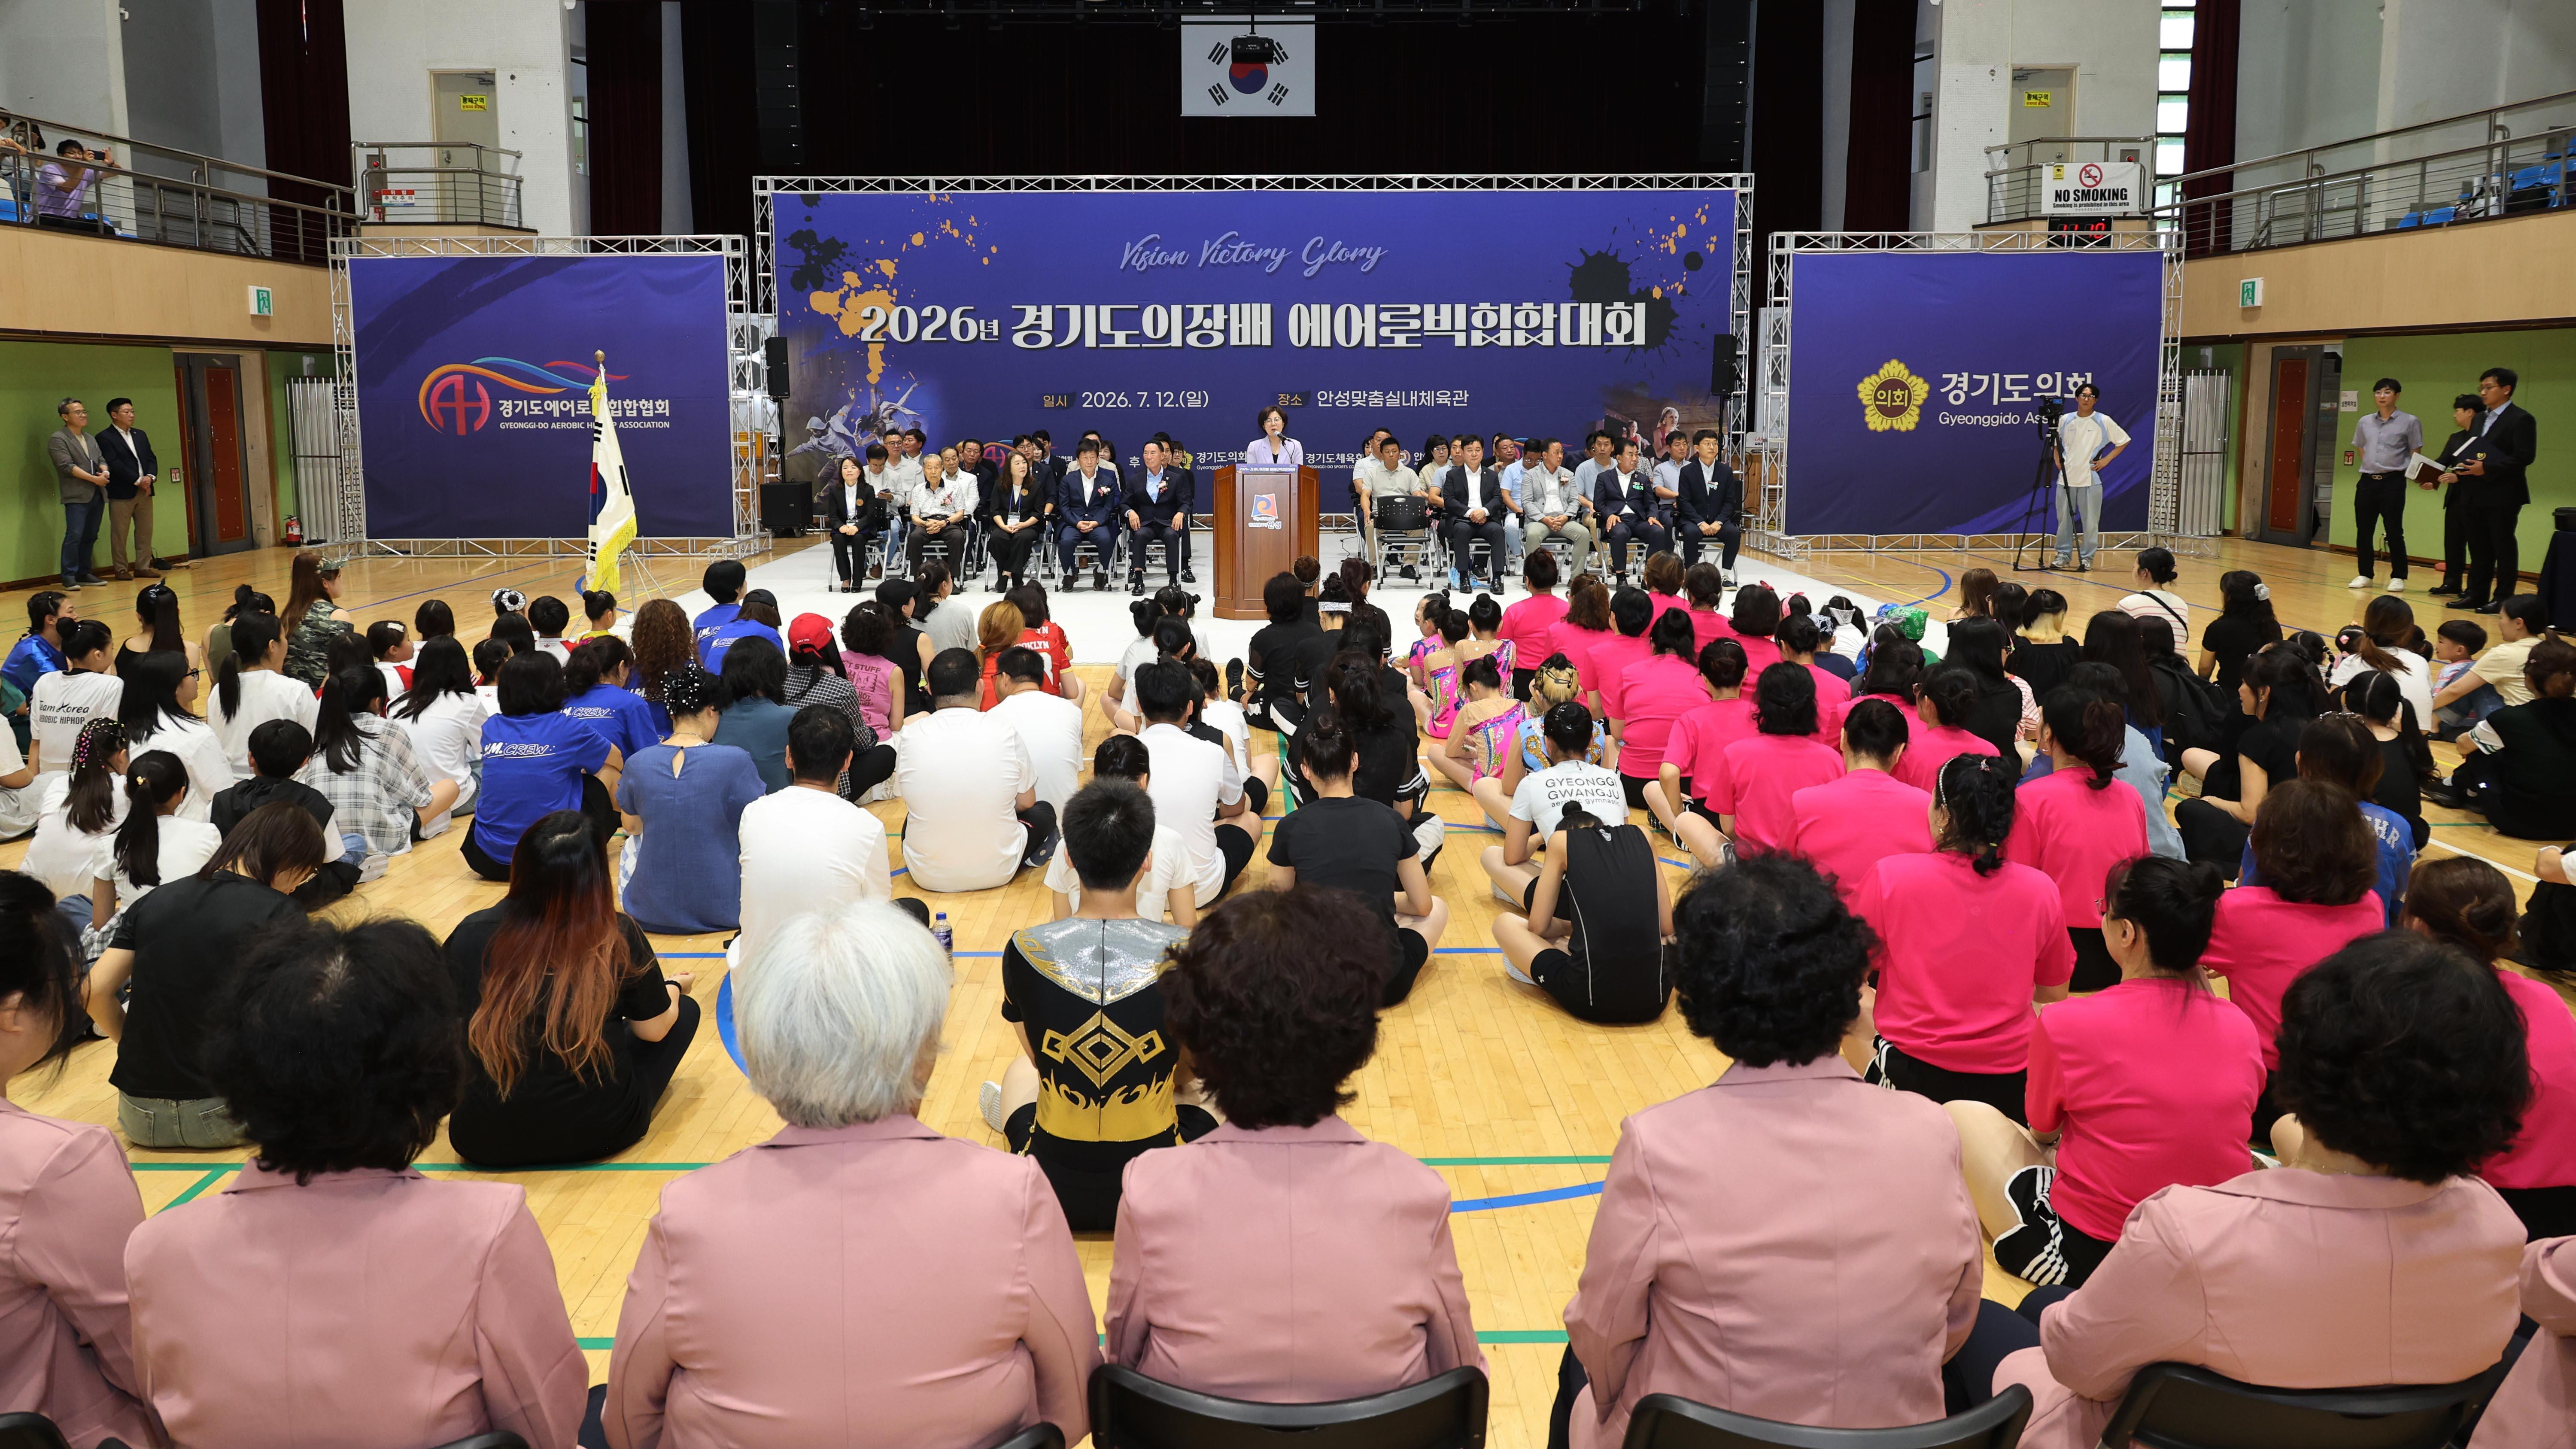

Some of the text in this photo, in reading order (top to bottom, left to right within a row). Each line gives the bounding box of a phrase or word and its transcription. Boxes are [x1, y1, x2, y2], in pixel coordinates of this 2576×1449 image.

[2054, 188, 2128, 202] NO SMOKING
[1119, 231, 1388, 277] Vision Victory Glory
[860, 302, 1646, 349] 2026년 경기도의장배 에어로빅힙합대회
[1940, 372, 2092, 405] 경기도의회
[1043, 395, 1067, 408] 일시
[1081, 391, 1132, 408] 2026.
[1136, 392, 1150, 407] 7.
[1278, 394, 1303, 407] 장소
[1317, 389, 1470, 407] 안성맞춤실내체육관
[1876, 388, 1909, 407] 의회
[499, 399, 670, 418] 경기도에어로힙합협회
[1939, 412, 2020, 427] Gyeonggido
[1196, 451, 1247, 464] 경기도의회
[56, 700, 90, 713] Korea
[60, 716, 85, 725] HIPHOP
[1545, 777, 1618, 788] GYEONGGI
[1548, 788, 1619, 800] GWANGJU
